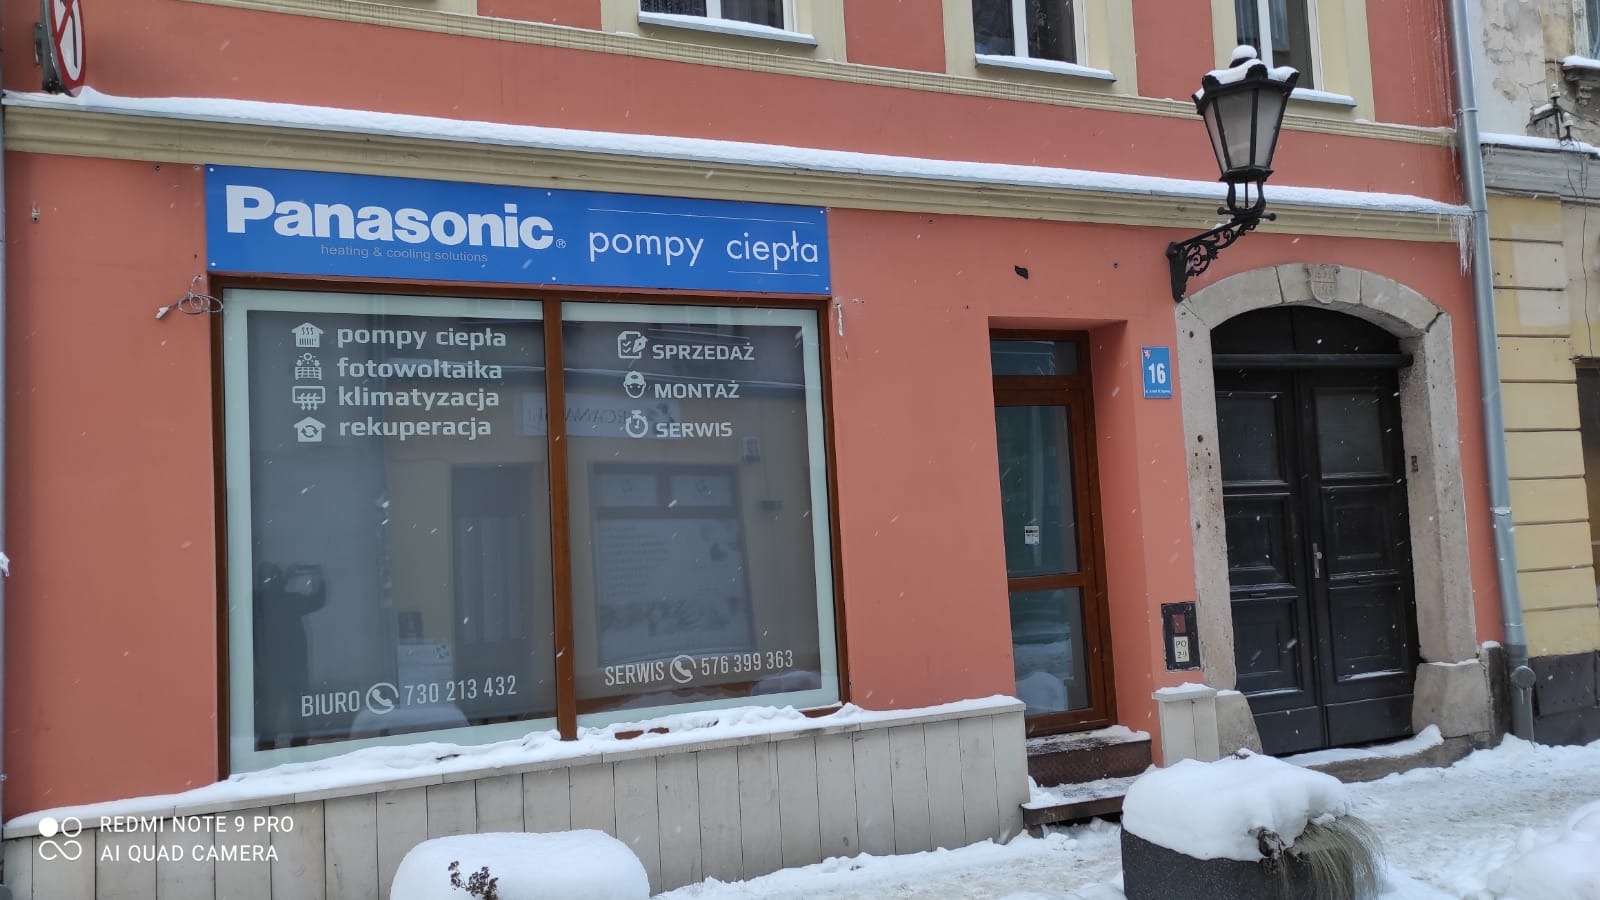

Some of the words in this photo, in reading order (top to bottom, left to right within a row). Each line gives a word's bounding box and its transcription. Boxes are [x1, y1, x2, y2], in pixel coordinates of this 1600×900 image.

[226, 184, 554, 250] Panasonic
[320, 244, 369, 259] heating
[373, 246, 383, 257] &
[387, 247, 431, 262] cooling
[434, 250, 489, 263] solutions
[589, 231, 704, 267] pompy
[726, 230, 818, 270] ciepła
[337, 327, 427, 350] pompy
[436, 327, 506, 351] ciepła
[652, 342, 755, 361] SPRZEDAŻ
[337, 356, 502, 379] fotowoltaika
[1148, 362, 1166, 384] 16
[338, 385, 499, 412] klimatyzacja
[654, 379, 740, 399] MONTAŻ
[339, 416, 491, 441] rekuperacja
[656, 421, 733, 438] SERWIS
[604, 661, 665, 687] SERWIS
[701, 655, 729, 676] 576
[733, 652, 762, 673] 399
[766, 649, 793, 670] 363
[301, 690, 360, 717] BIURO
[404, 682, 439, 706] 730
[446, 678, 478, 702] 213
[483, 675, 517, 698] 432
